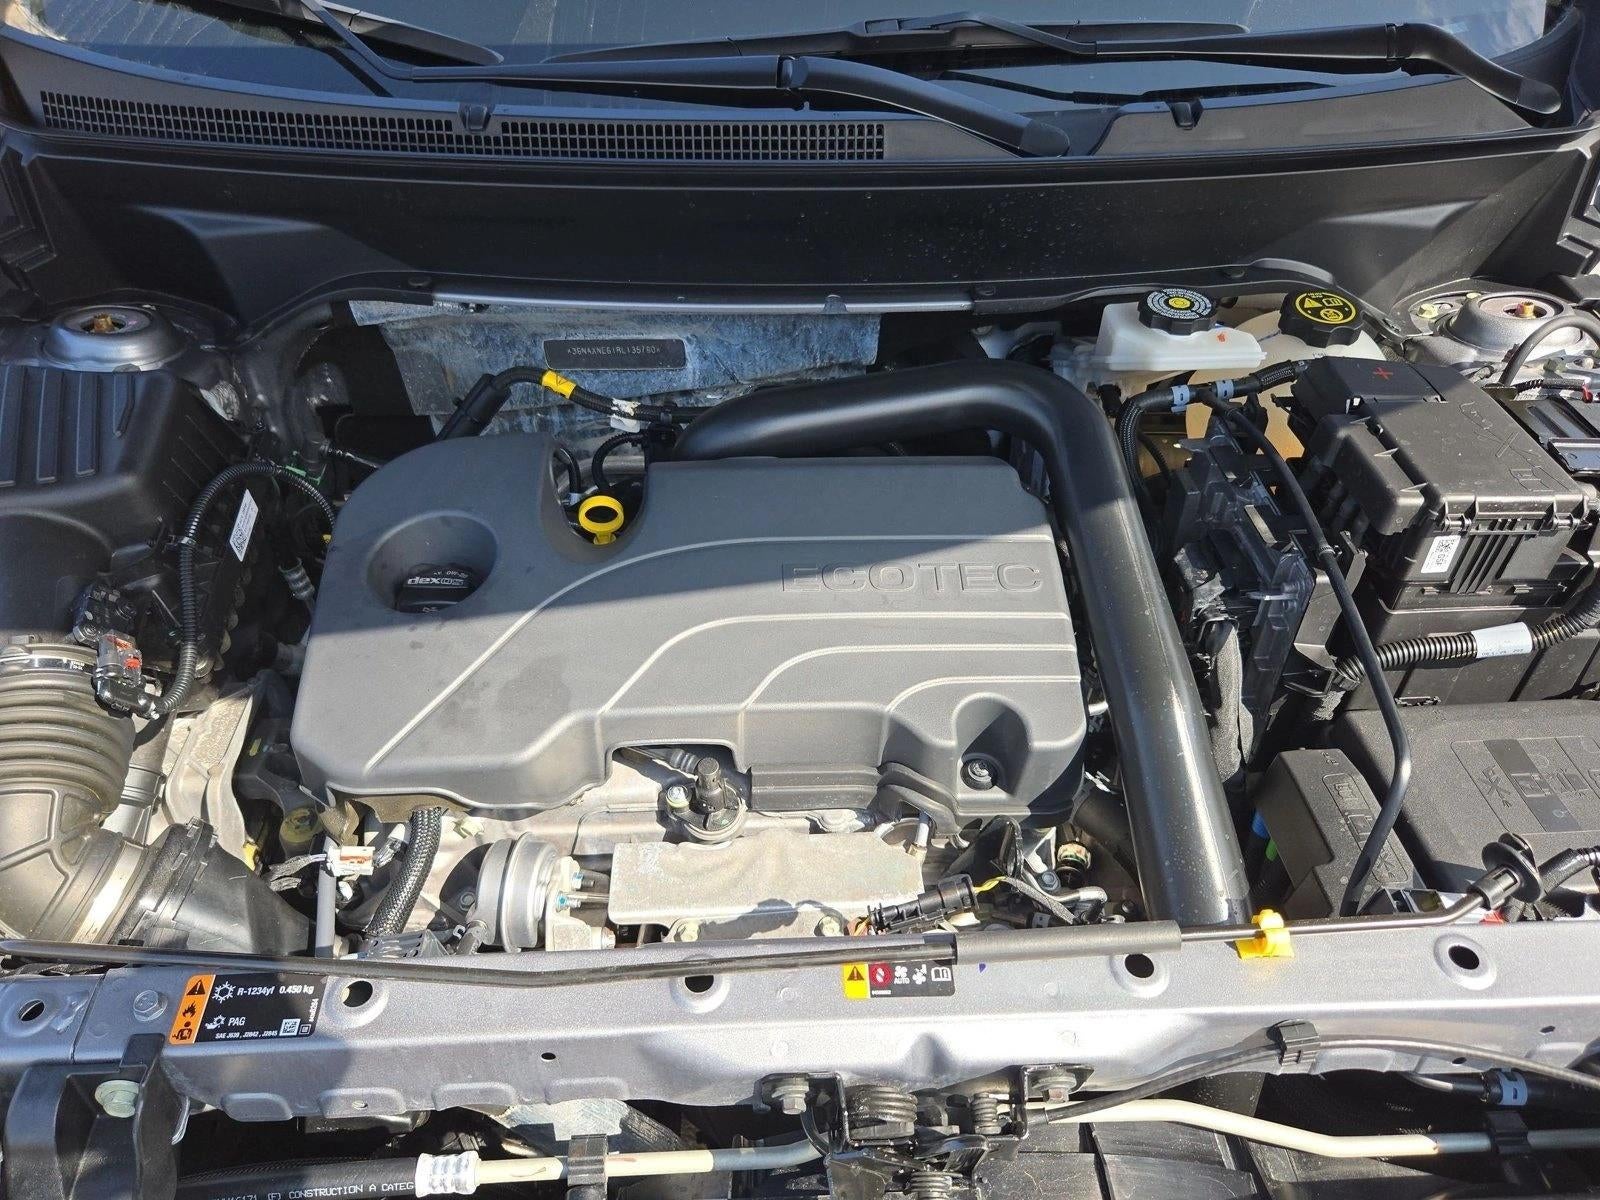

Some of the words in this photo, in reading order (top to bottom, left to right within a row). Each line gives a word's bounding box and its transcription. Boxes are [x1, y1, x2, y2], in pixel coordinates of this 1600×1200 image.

[407, 576, 464, 586] dexos
[781, 562, 1043, 592] ECOTEC
[236, 985, 275, 996] R-1234yf
[279, 985, 302, 995] 0.450
[302, 985, 314, 995] kg
[227, 1016, 246, 1027] PAG
[288, 1184, 363, 1199] CONSTRUCTION
[369, 1183, 377, 1192] A
[381, 1181, 414, 1192] CATEG
